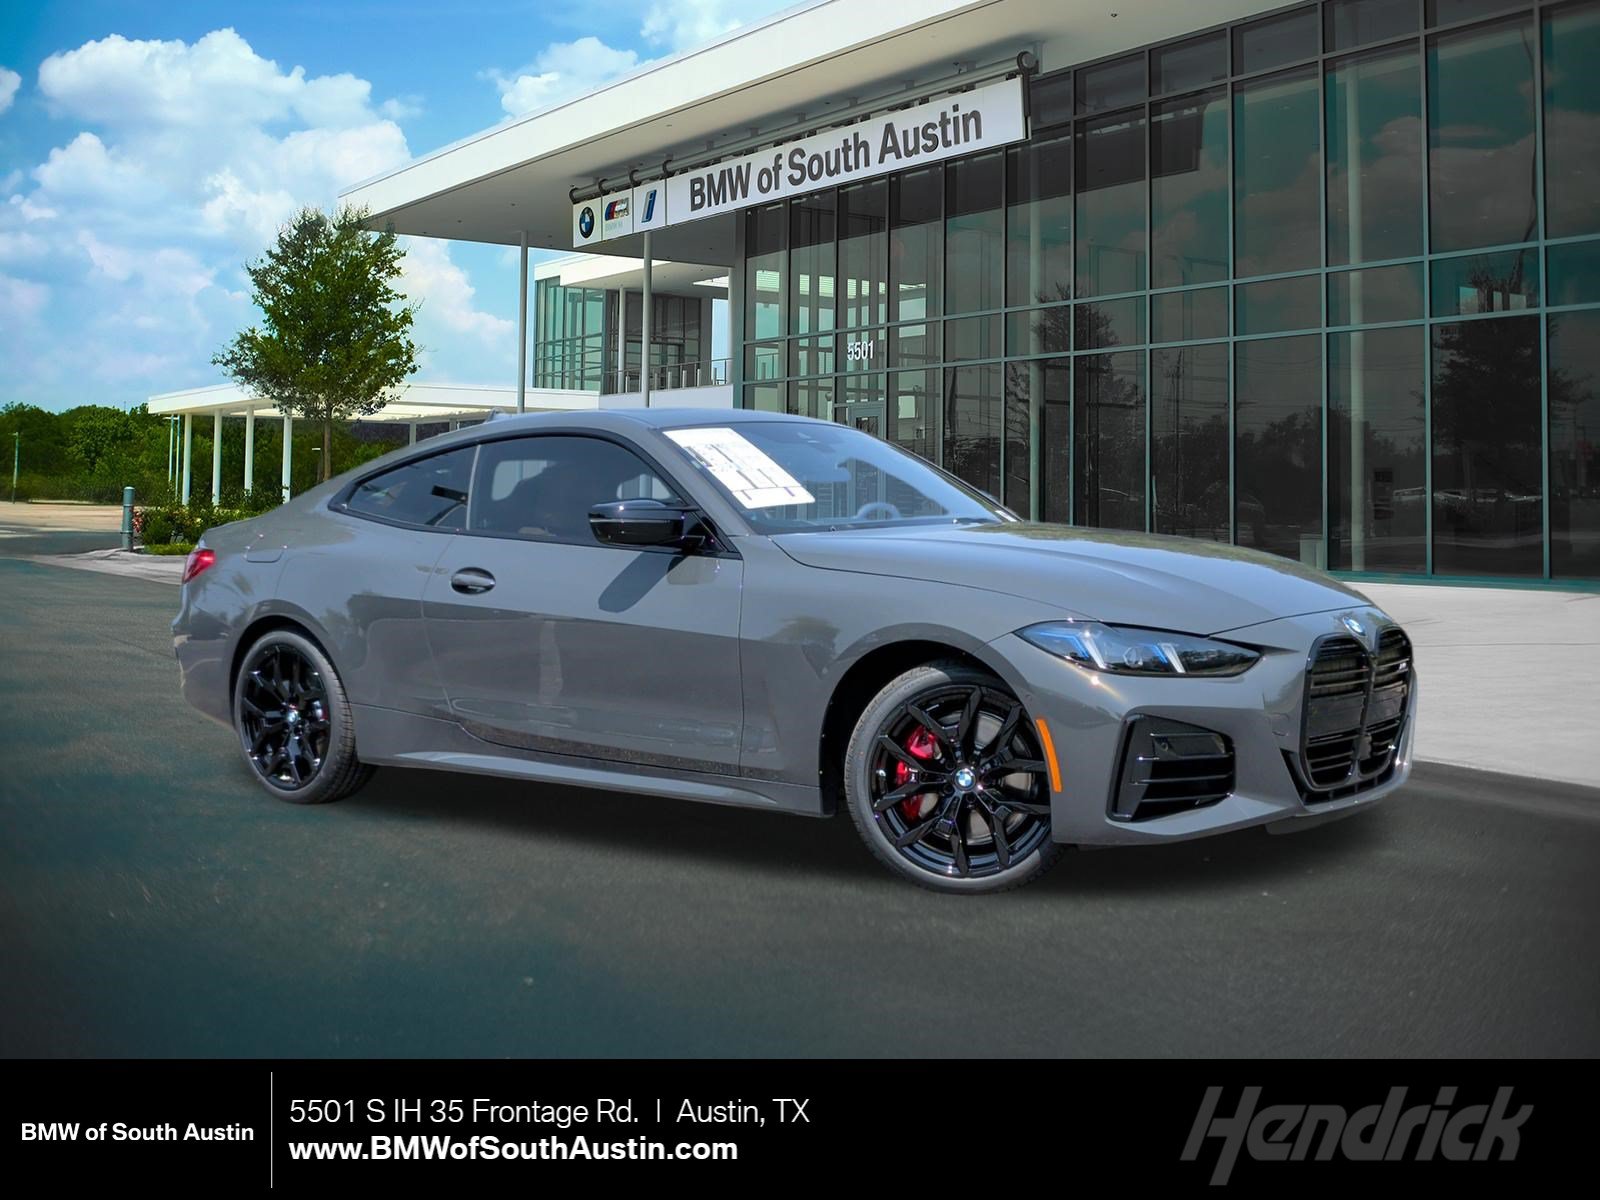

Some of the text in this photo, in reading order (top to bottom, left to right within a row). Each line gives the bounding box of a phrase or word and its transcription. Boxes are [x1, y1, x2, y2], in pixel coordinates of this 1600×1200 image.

[690, 103, 983, 211] BMW of South Austin
[847, 340, 874, 361] 5501
